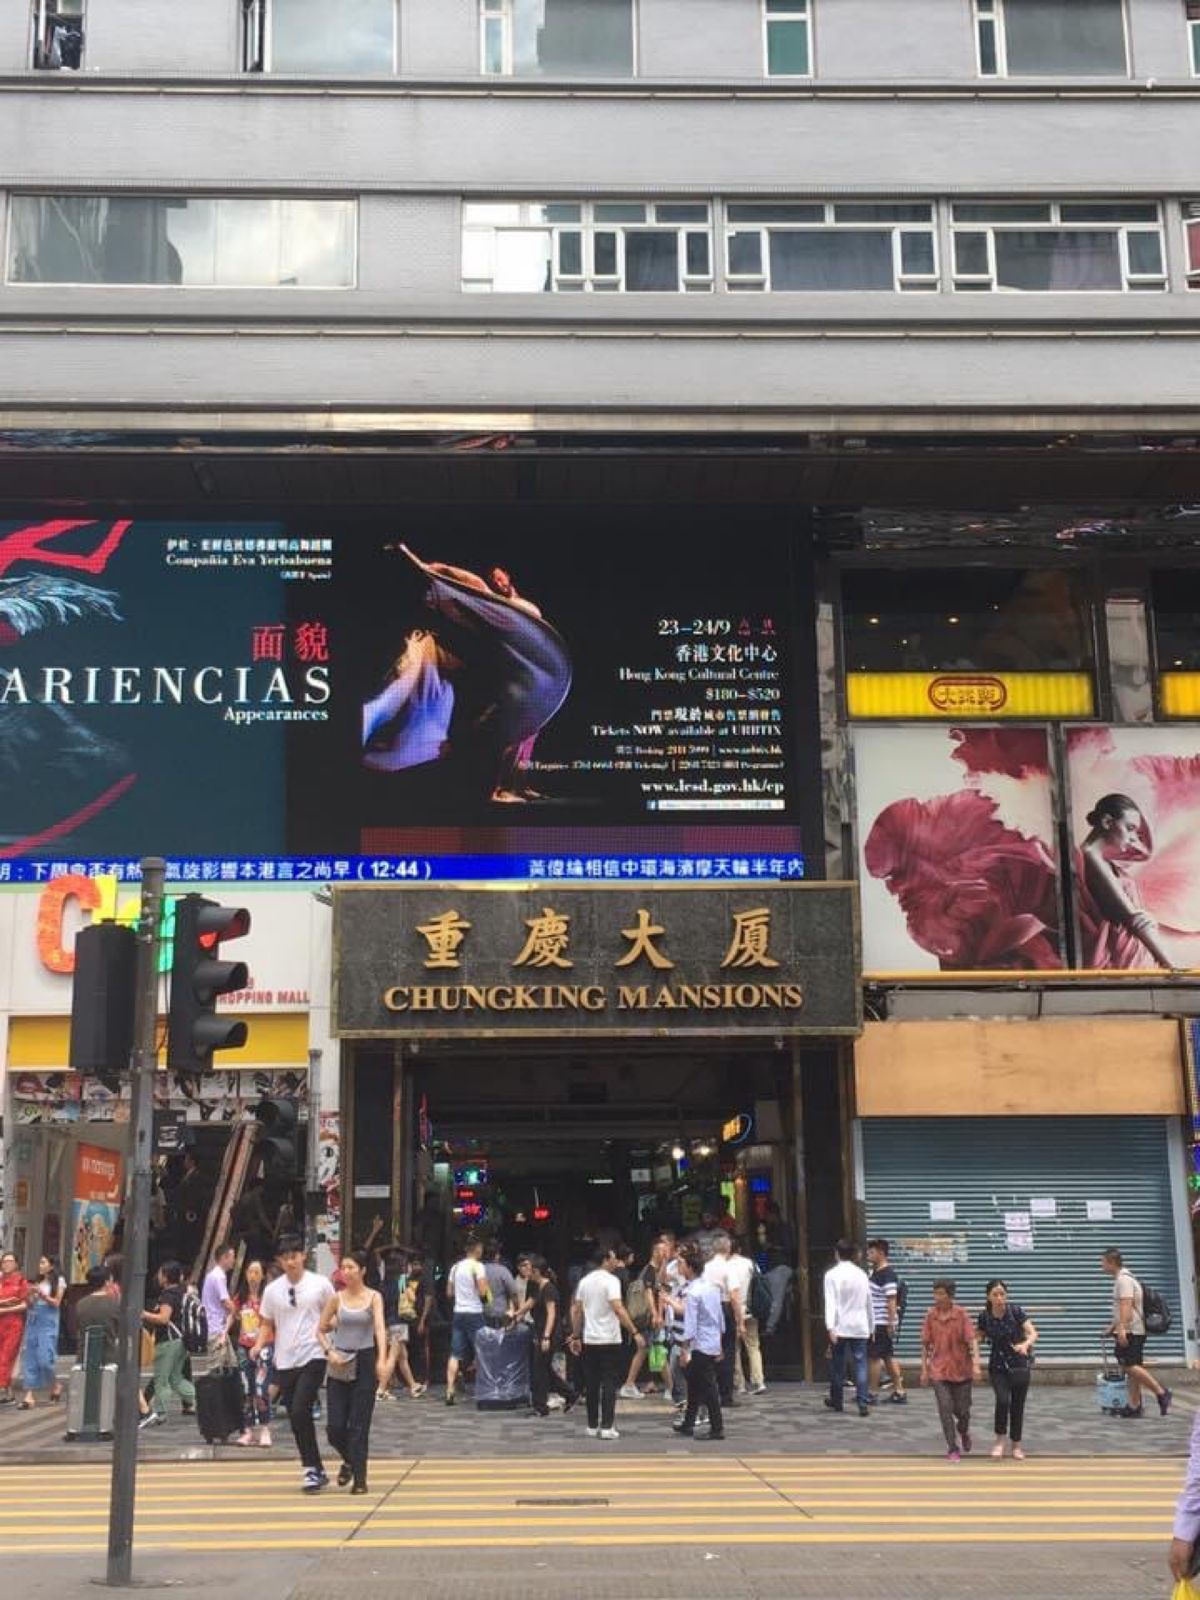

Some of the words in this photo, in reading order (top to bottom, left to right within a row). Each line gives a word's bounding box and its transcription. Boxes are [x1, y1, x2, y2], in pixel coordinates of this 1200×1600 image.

[232, 554, 256, 566] Eva
[260, 553, 333, 566] Yerbabuena
[251, 622, 330, 662] 面貌
[676, 643, 778, 663] 香港文化中心
[619, 667, 651, 682] Hong
[654, 667, 686, 682] Kong
[688, 667, 736, 681] Cultural
[739, 667, 779, 681] Centre
[0, 666, 331, 704] ARIENCIAS
[223, 707, 329, 726] Appearances
[591, 724, 630, 736] Tickets
[633, 724, 663, 736] NOW
[667, 724, 716, 736] available
[718, 725, 729, 736] at
[640, 778, 785, 795] www.lcsd.gov.hk/cp
[277, 990, 310, 1003] MALL
[383, 983, 608, 1013] CHUNGKING
[617, 982, 803, 1011] MANSIONS
